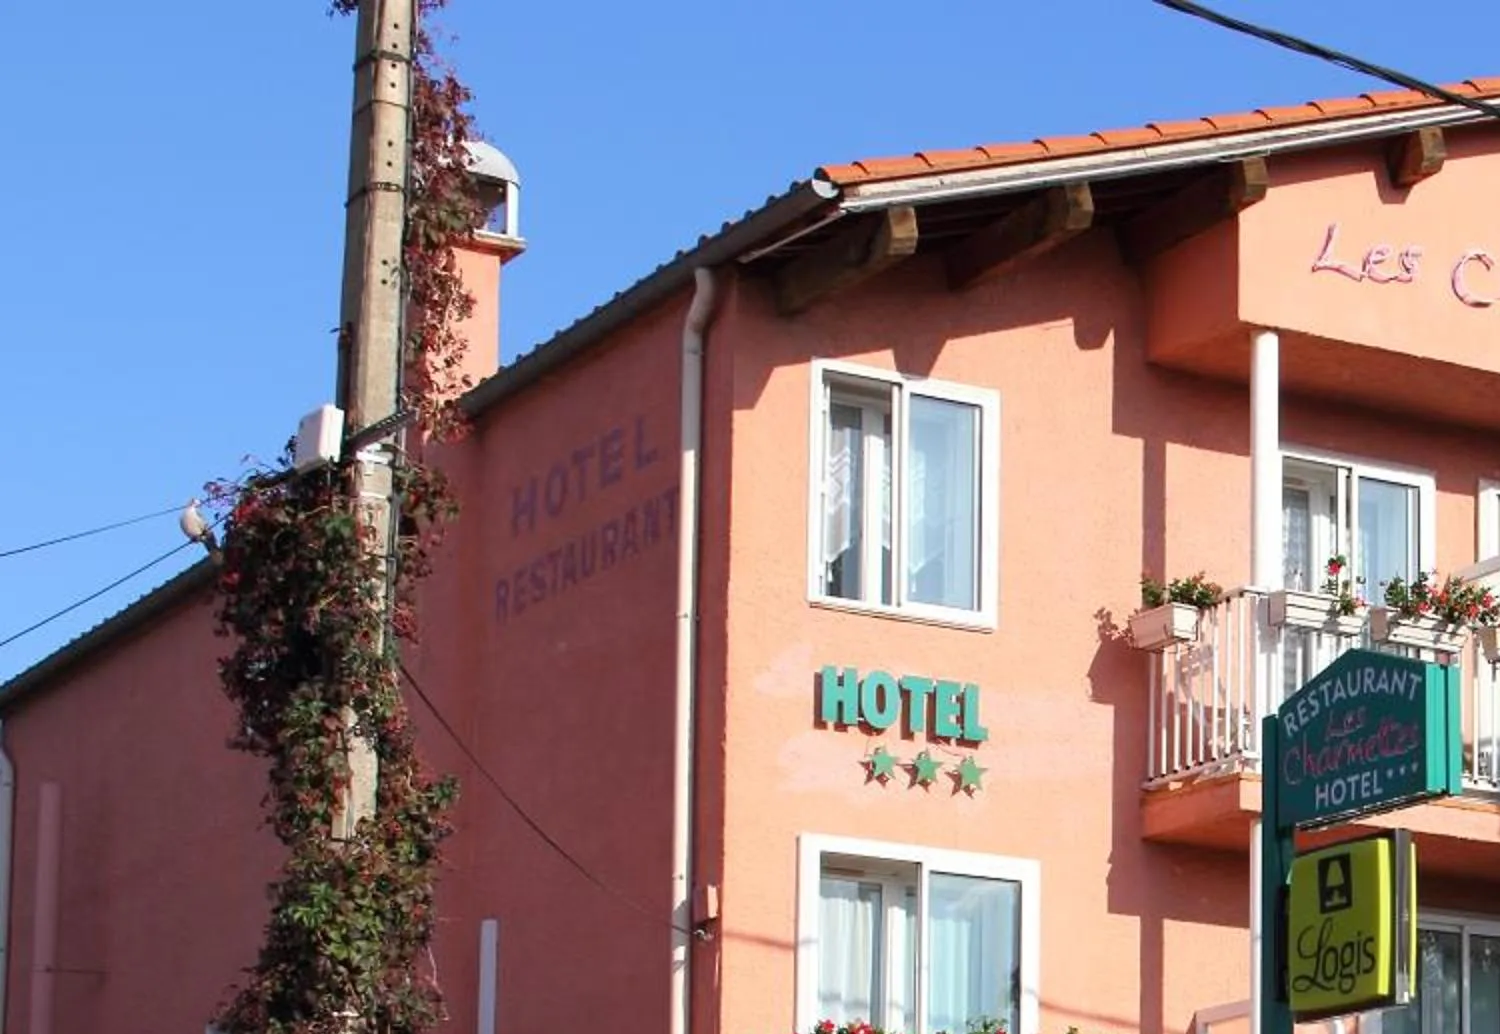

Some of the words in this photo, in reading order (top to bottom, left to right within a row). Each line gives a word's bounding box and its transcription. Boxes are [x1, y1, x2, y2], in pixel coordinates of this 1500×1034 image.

[1312, 221, 1423, 283] Les
[510, 415, 660, 538] HOTEL
[495, 484, 681, 624] RESTAURANT
[818, 665, 989, 743] HOTEL
[1283, 667, 1423, 736] RESTAURANT
[1325, 705, 1367, 741] Les
[1315, 769, 1384, 811] HOTEL
[1292, 917, 1377, 994] Logis
